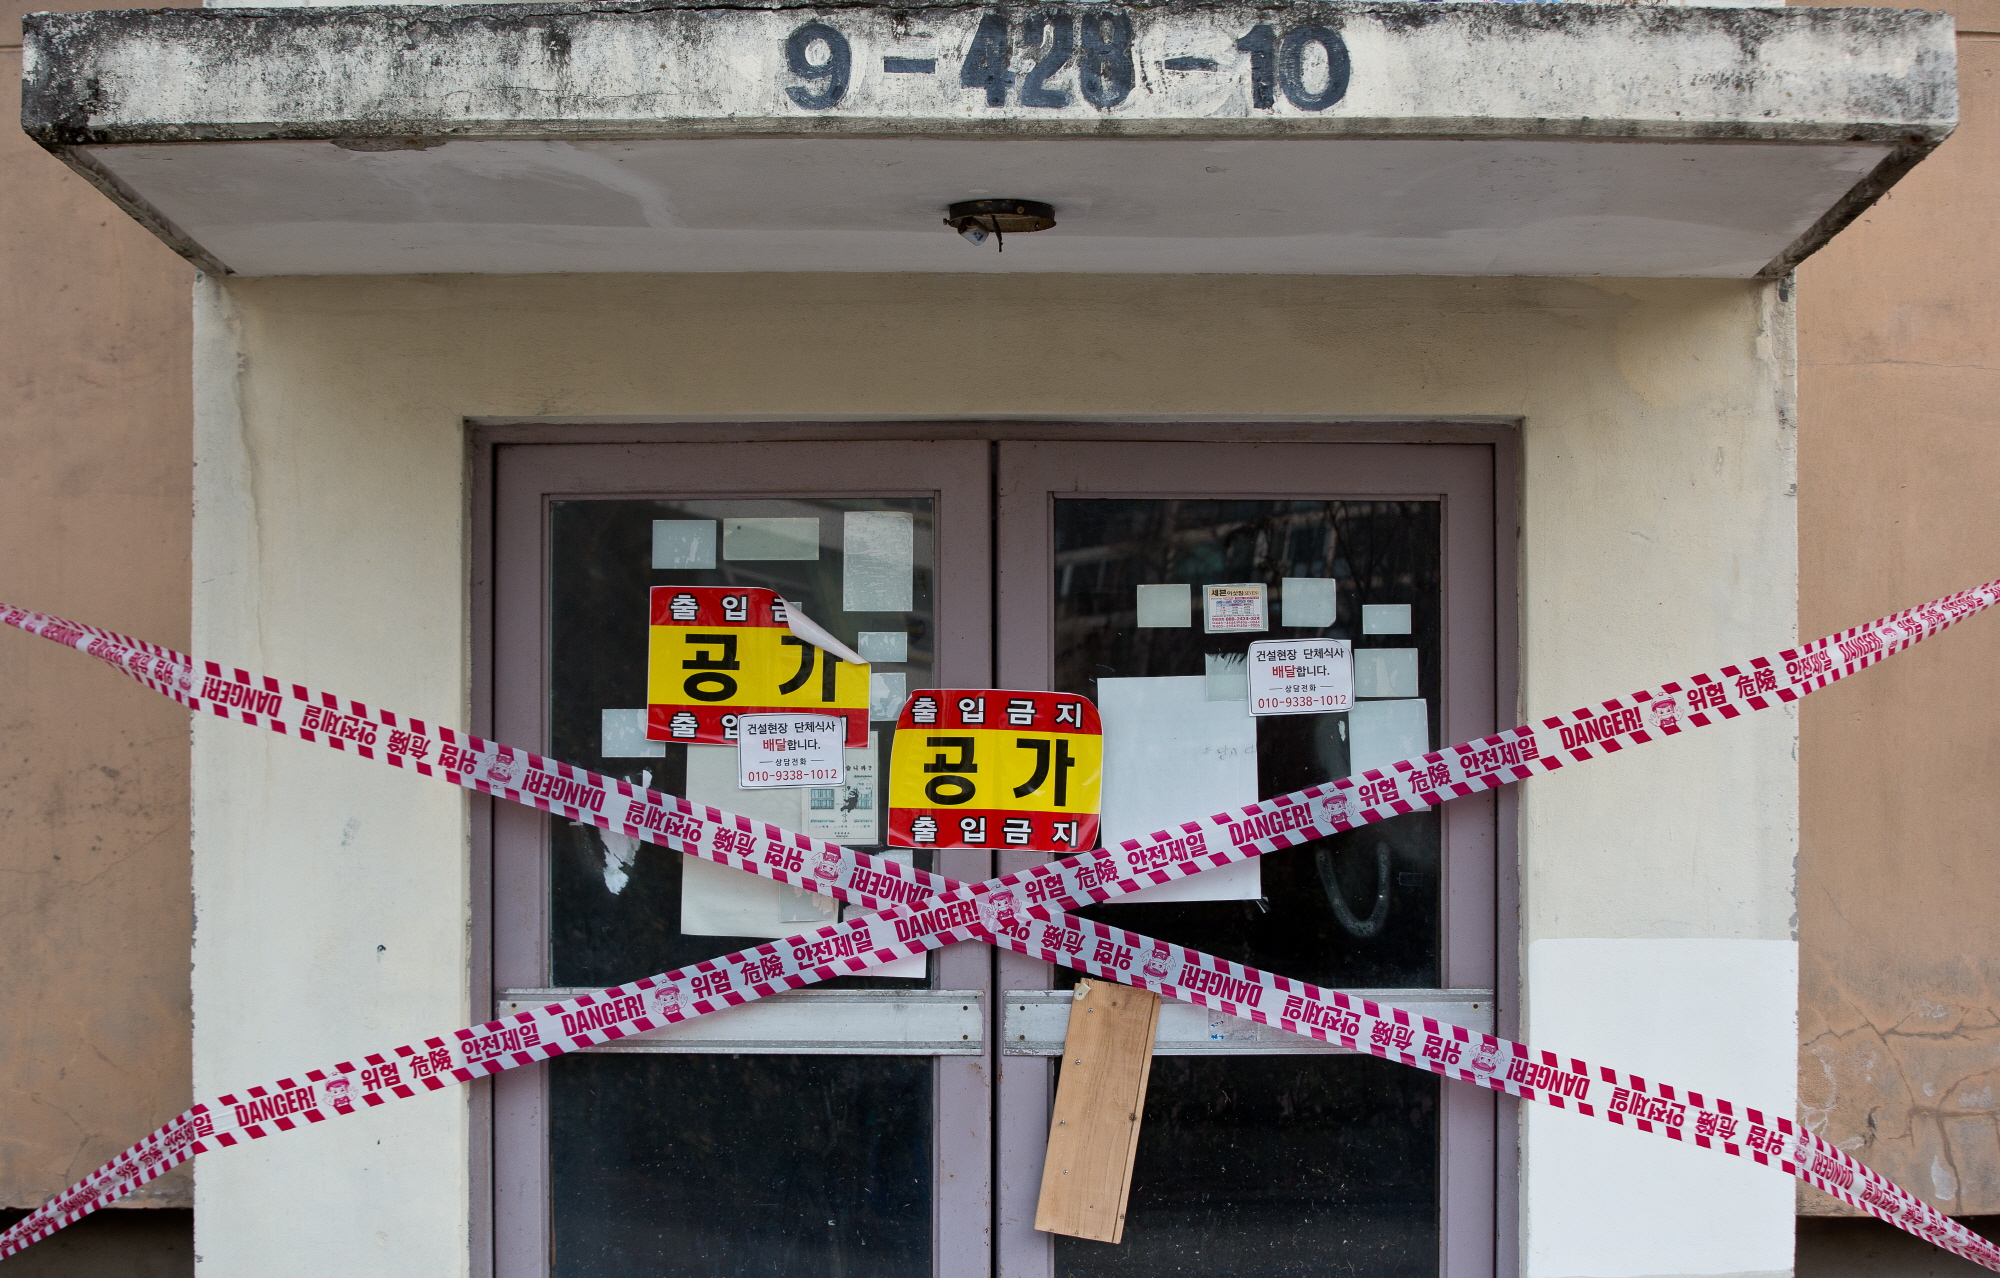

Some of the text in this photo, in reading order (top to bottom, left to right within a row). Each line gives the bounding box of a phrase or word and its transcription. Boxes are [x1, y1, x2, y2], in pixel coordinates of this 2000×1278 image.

[682, 633, 844, 702] 공가
[1256, 647, 1344, 662] 건설현장 단체식사
[1272, 665, 1330, 678] 배달합니다.
[200, 676, 283, 718] DANGER!
[1258, 694, 1347, 708] 010-9338-1012
[301, 704, 378, 746] 안전제일
[747, 721, 836, 735] 건설현장 단체식사
[386, 728, 432, 760] 危險
[438, 743, 478, 775] 위험
[762, 738, 821, 751] 배달합니다.
[748, 768, 837, 782] 010-9338-1012
[923, 736, 1075, 807] 공가
[521, 768, 606, 813] DANGER!
[624, 799, 703, 843] 안전제일
[712, 826, 758, 858] 危險
[764, 841, 805, 873] 위험
[234, 1085, 317, 1128] DANGER!
[361, 1062, 400, 1091] 위험
[409, 1047, 453, 1079] 危險
[461, 1023, 541, 1064] 안전제일
[561, 994, 646, 1037] DANGER!
[691, 969, 731, 1000] 위험
[740, 955, 785, 987] 危險
[793, 927, 874, 969] 안전제일
[894, 898, 980, 942] DANGER!
[1025, 873, 1066, 903] 위험
[1074, 858, 1119, 891] 危險
[1127, 833, 1208, 875] 안전제일
[1228, 804, 1312, 846] DANGER!
[1358, 777, 1399, 807] 위험
[1408, 762, 1452, 795] 危險
[1459, 736, 1539, 778] 안전제일
[1559, 706, 1644, 750] DANGER!
[1686, 682, 1727, 711] 위험
[1734, 668, 1779, 699] 危險
[1040, 924, 1086, 956] 危險
[1093, 939, 1133, 971] 위험
[1177, 963, 1263, 1008] DANGER!
[1282, 994, 1362, 1037] 안전제일
[1370, 1019, 1416, 1051] 危險
[1421, 1034, 1462, 1065] 위험
[1505, 1057, 1590, 1100] DANGER!
[1609, 1087, 1687, 1127] 안전제일
[1694, 1110, 1739, 1141] 危險
[1745, 1124, 1786, 1156] 위험
